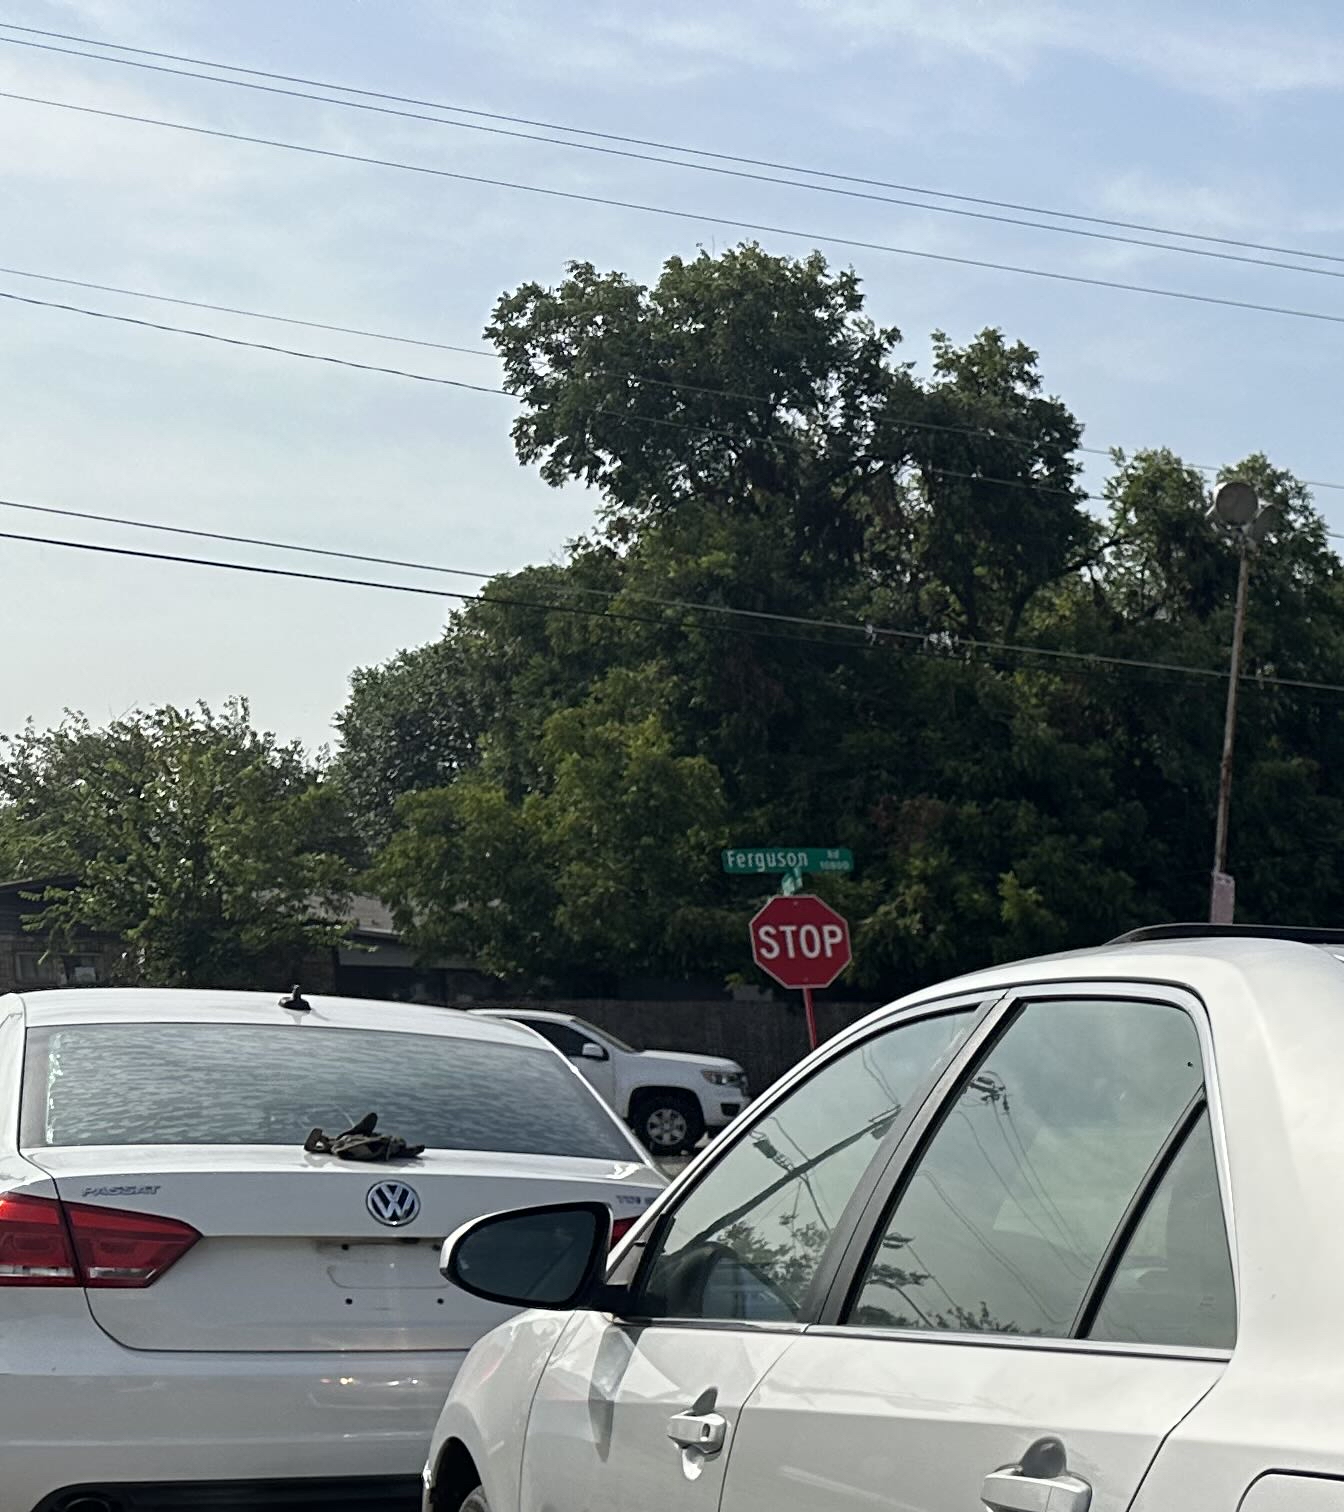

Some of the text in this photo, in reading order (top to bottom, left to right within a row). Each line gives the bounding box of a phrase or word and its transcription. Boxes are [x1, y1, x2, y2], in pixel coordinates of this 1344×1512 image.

[727, 850, 808, 872] Ferguson
[759, 924, 843, 959] STOP
[82, 1185, 162, 1197] PASSAT
